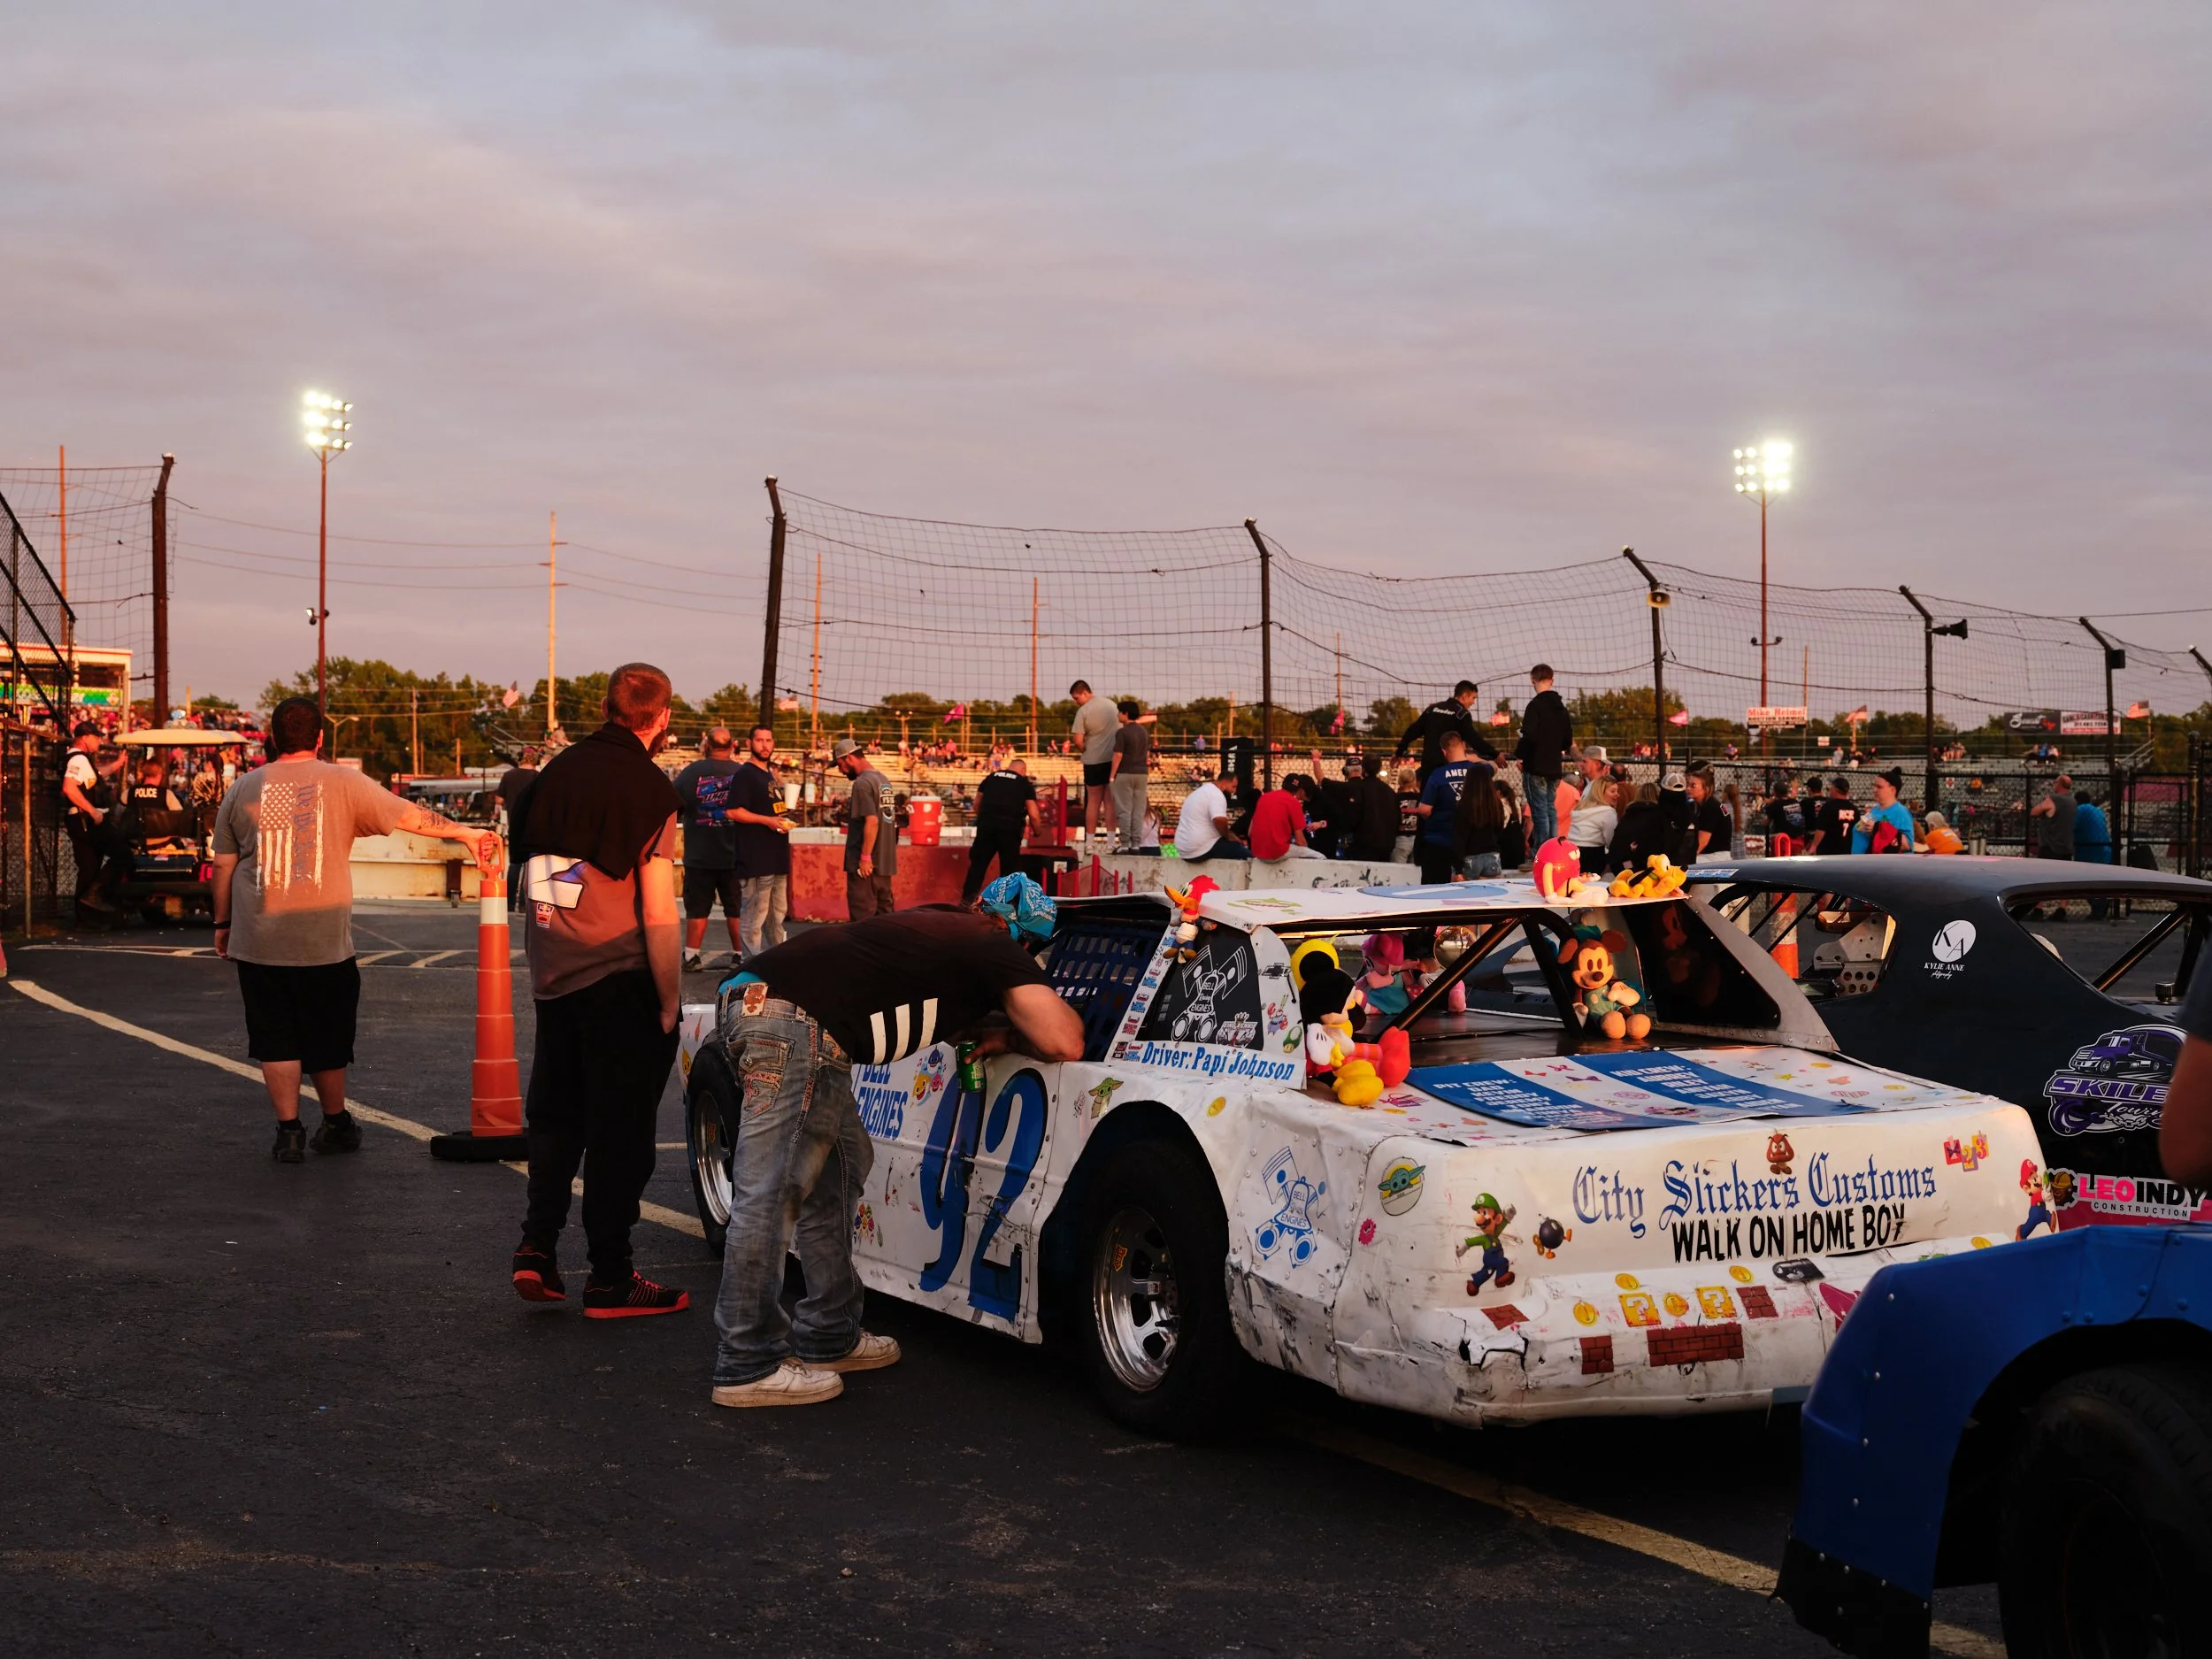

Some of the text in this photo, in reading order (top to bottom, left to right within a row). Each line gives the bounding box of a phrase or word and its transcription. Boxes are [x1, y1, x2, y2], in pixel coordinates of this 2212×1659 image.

[134, 787, 157, 798] POLICE
[1203, 982, 1215, 991] BELL
[1190, 1003, 1211, 1013] ENGINES
[1141, 1041, 1193, 1070] Driver:
[1192, 1047, 1230, 1077] Papi
[1228, 1052, 1295, 1081] Johnson
[2049, 1076, 2172, 1104] SKILE
[856, 1087, 909, 1141] ENGINES
[2101, 1100, 2163, 1118] Towin
[919, 1067, 1048, 1322] 92
[1293, 1190, 1306, 1202] BELL
[1572, 1151, 1938, 1239] City Slickers Customs
[2093, 1202, 2188, 1217] CONSTRUCTION
[1280, 1212, 1308, 1228] ENGINES
[1672, 1202, 1907, 1263] WALK ON HOME BOY
